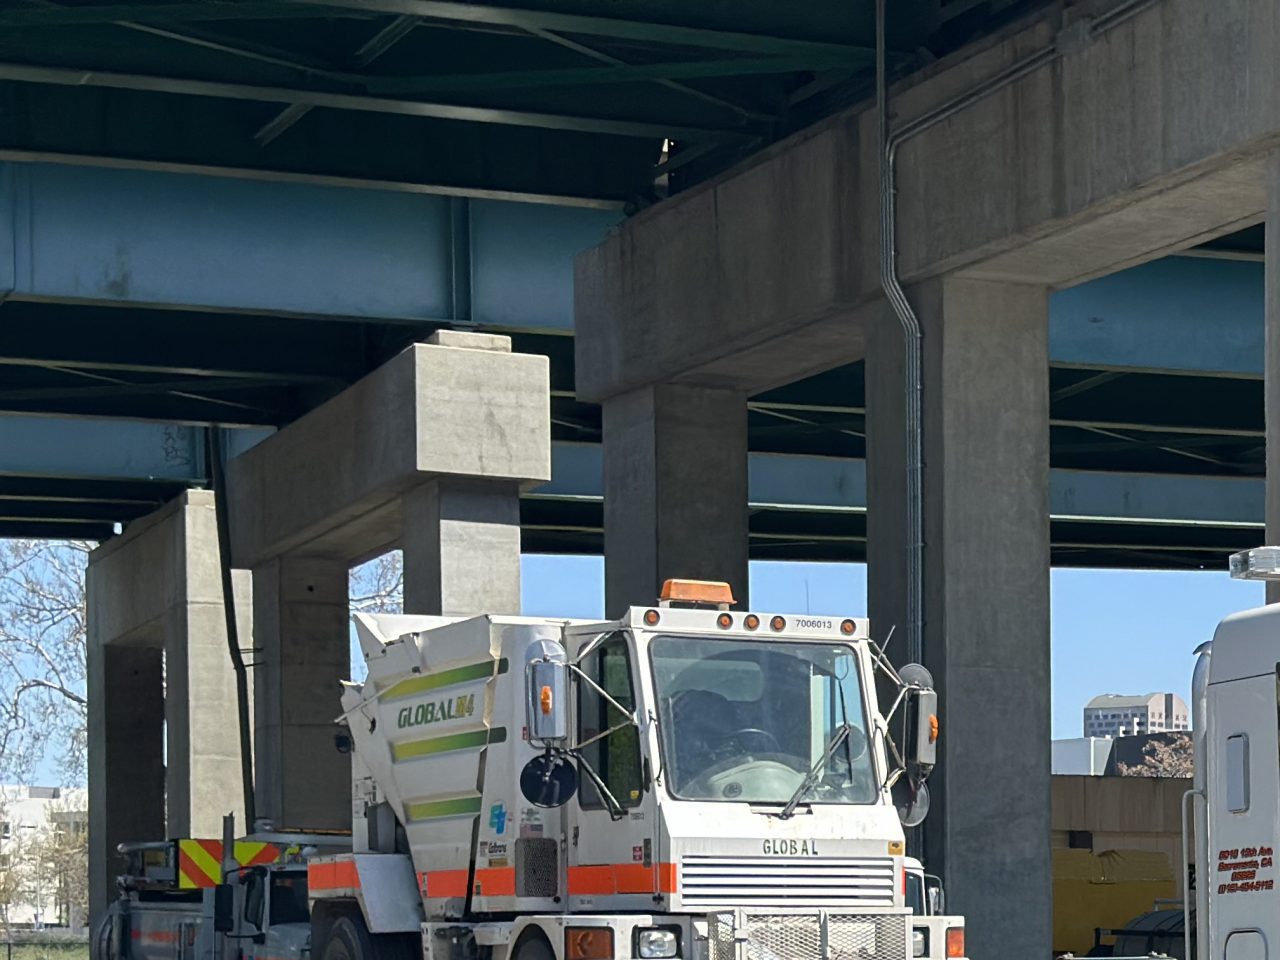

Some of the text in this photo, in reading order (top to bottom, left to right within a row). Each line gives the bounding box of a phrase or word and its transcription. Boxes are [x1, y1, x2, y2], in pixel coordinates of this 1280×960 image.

[795, 619, 833, 629] 7006013
[397, 698, 457, 729] GLOBAL
[762, 839, 819, 856] GLOBAL
